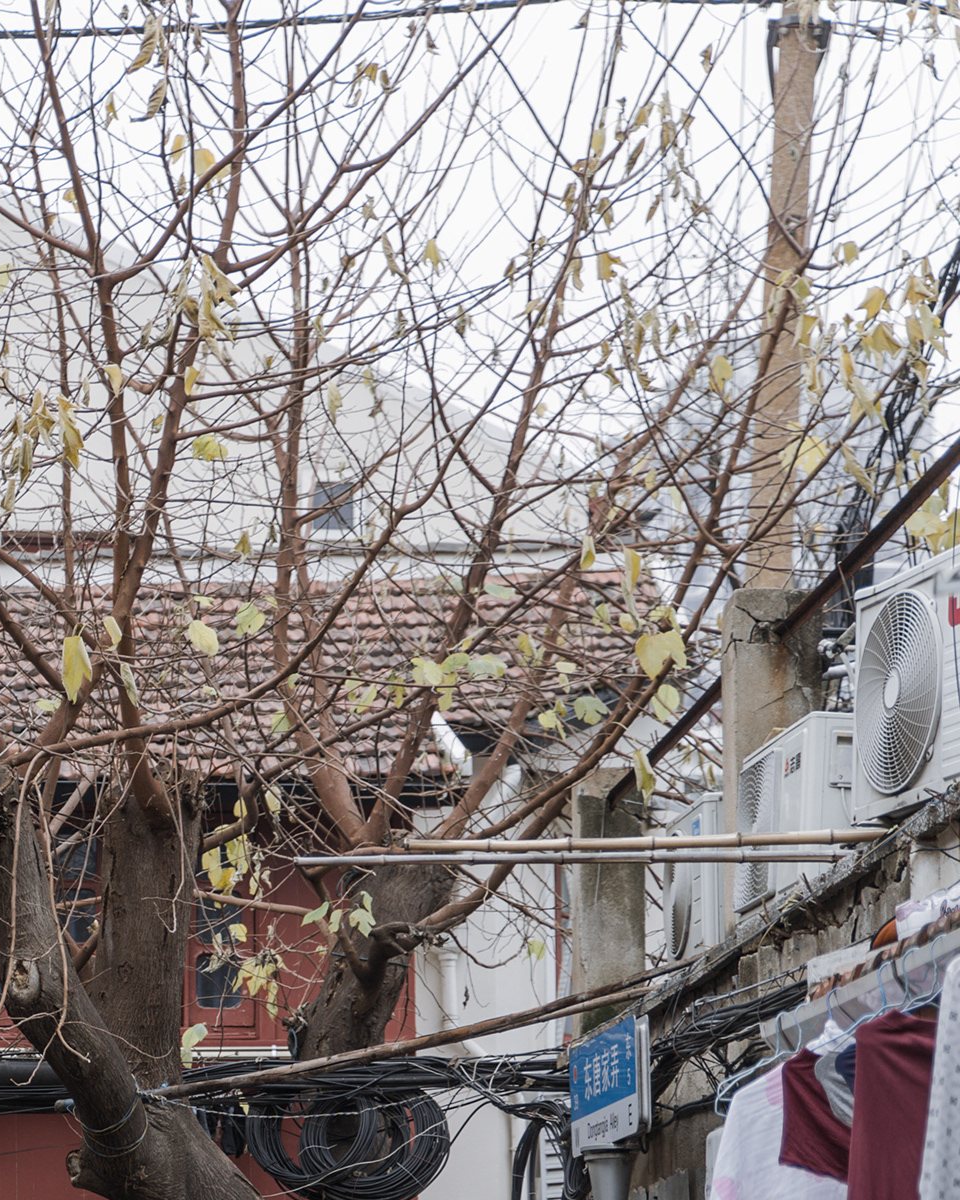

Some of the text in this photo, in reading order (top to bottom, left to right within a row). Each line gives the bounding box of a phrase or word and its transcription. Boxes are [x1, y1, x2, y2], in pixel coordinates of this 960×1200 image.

[584, 1044, 619, 1101] 东唐家弄
[628, 1103, 633, 1127] E
